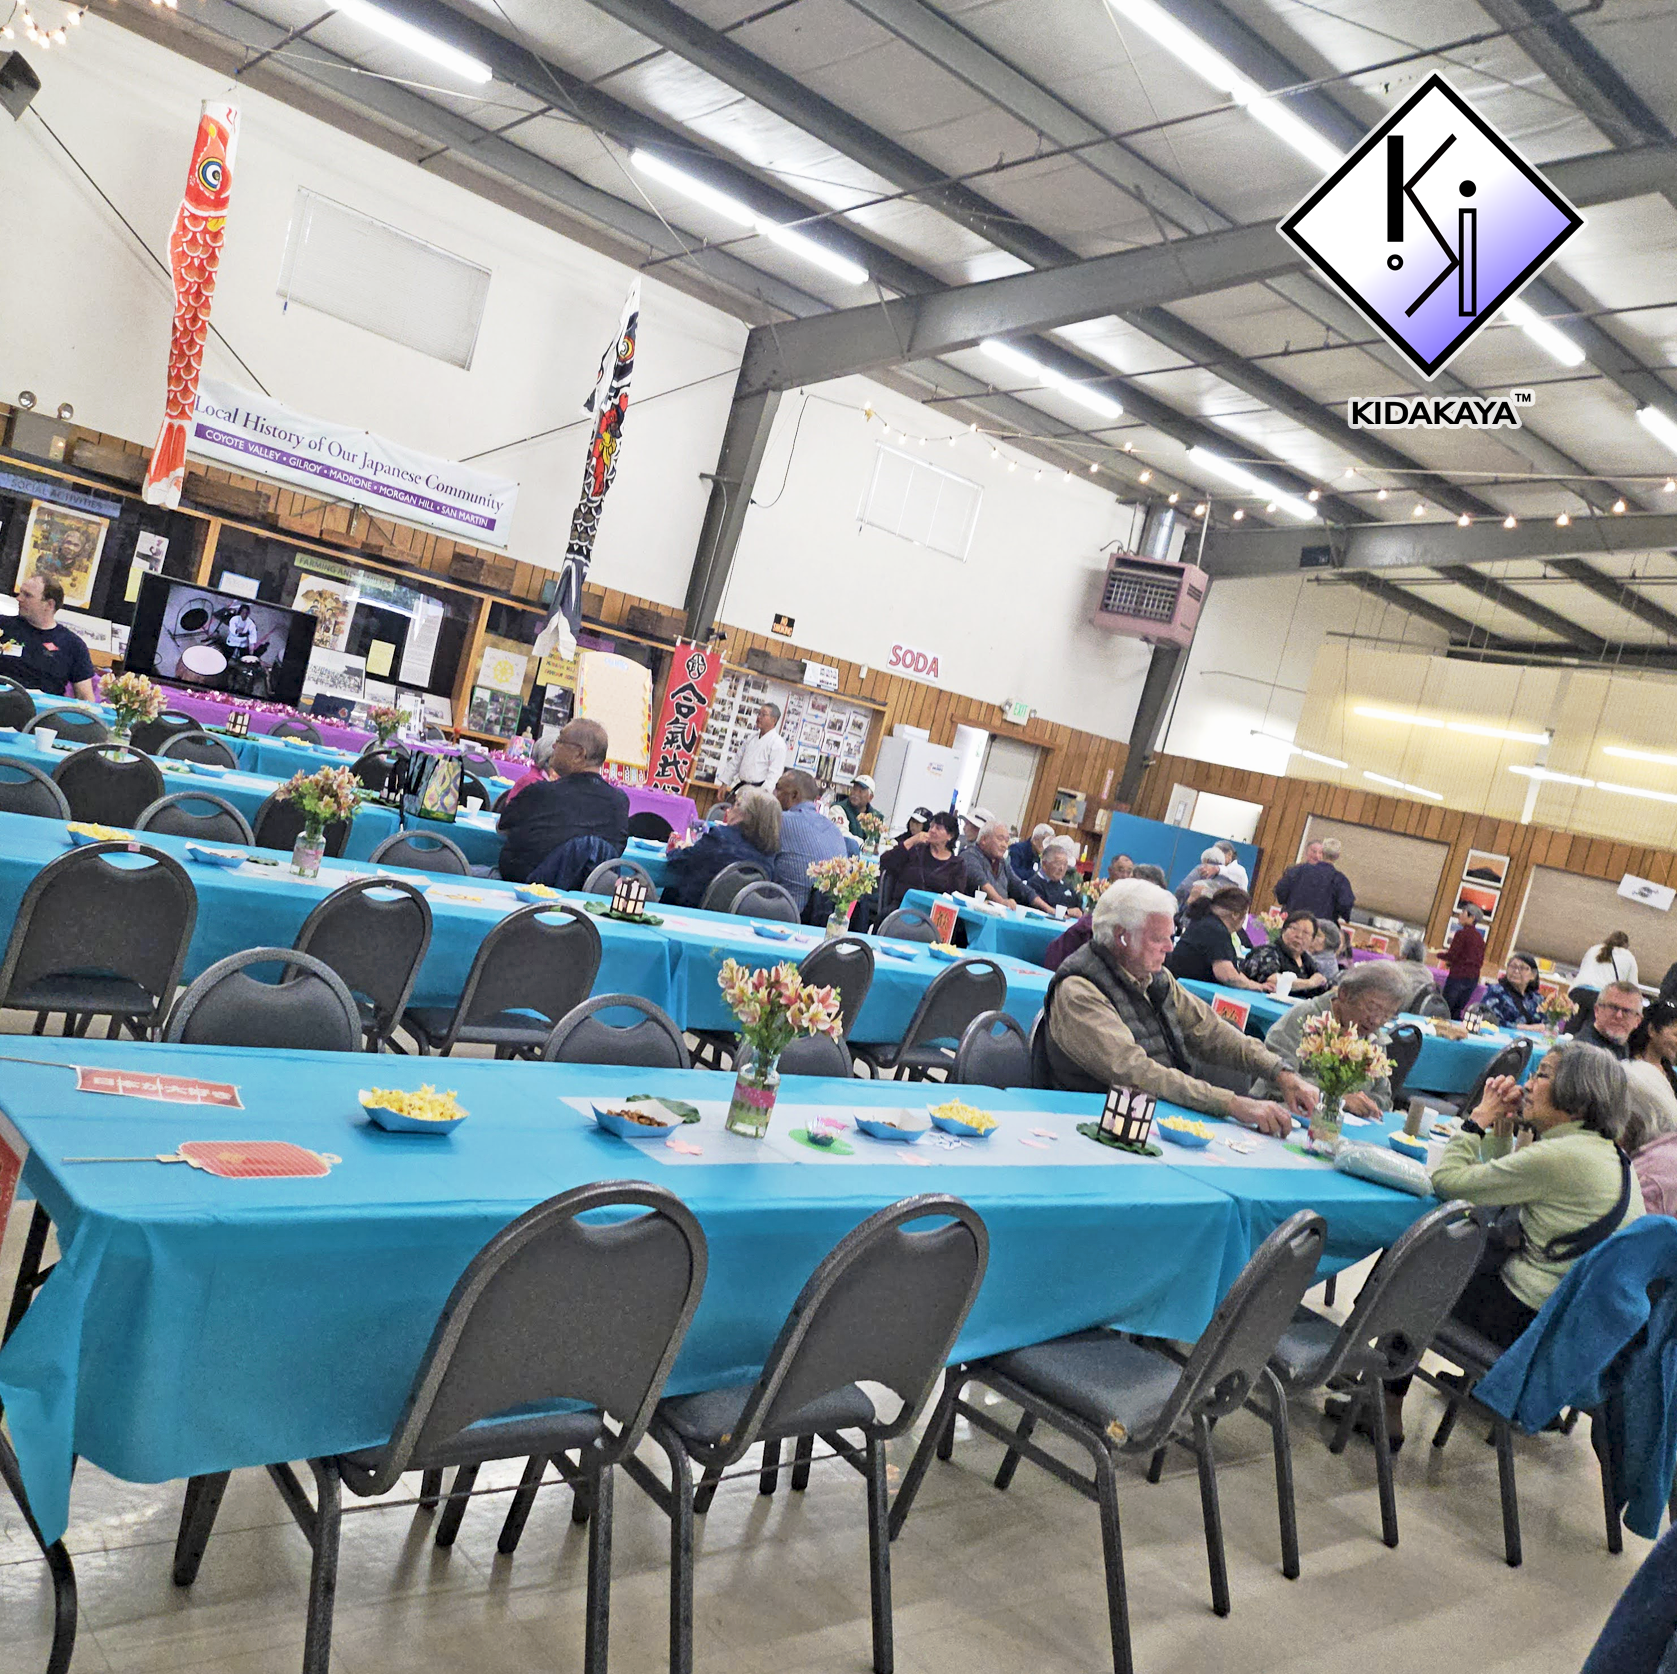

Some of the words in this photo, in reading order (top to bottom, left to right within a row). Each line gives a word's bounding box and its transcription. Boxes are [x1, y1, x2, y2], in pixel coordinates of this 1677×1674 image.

[194, 395, 239, 424] Local
[243, 412, 305, 449] History
[308, 436, 327, 452] of
[328, 440, 358, 463] Our
[359, 451, 422, 485] Japanese
[425, 474, 504, 514] Community
[10, 479, 48, 496] SOCIAL
[50, 489, 103, 509] ACTIVITIES
[205, 429, 245, 450] COYOTE
[248, 440, 282, 461] VALLEY
[289, 456, 323, 474] GILROY
[329, 469, 372, 491] MADRONE
[379, 485, 418, 506] MORGAN
[418, 496, 435, 511] HILL
[440, 505, 457, 518] SAN
[458, 509, 489, 527] MARTIN
[299, 556, 336, 573] FARMING
[888, 644, 939, 678] SODA
[1013, 702, 1029, 718] EXIT
